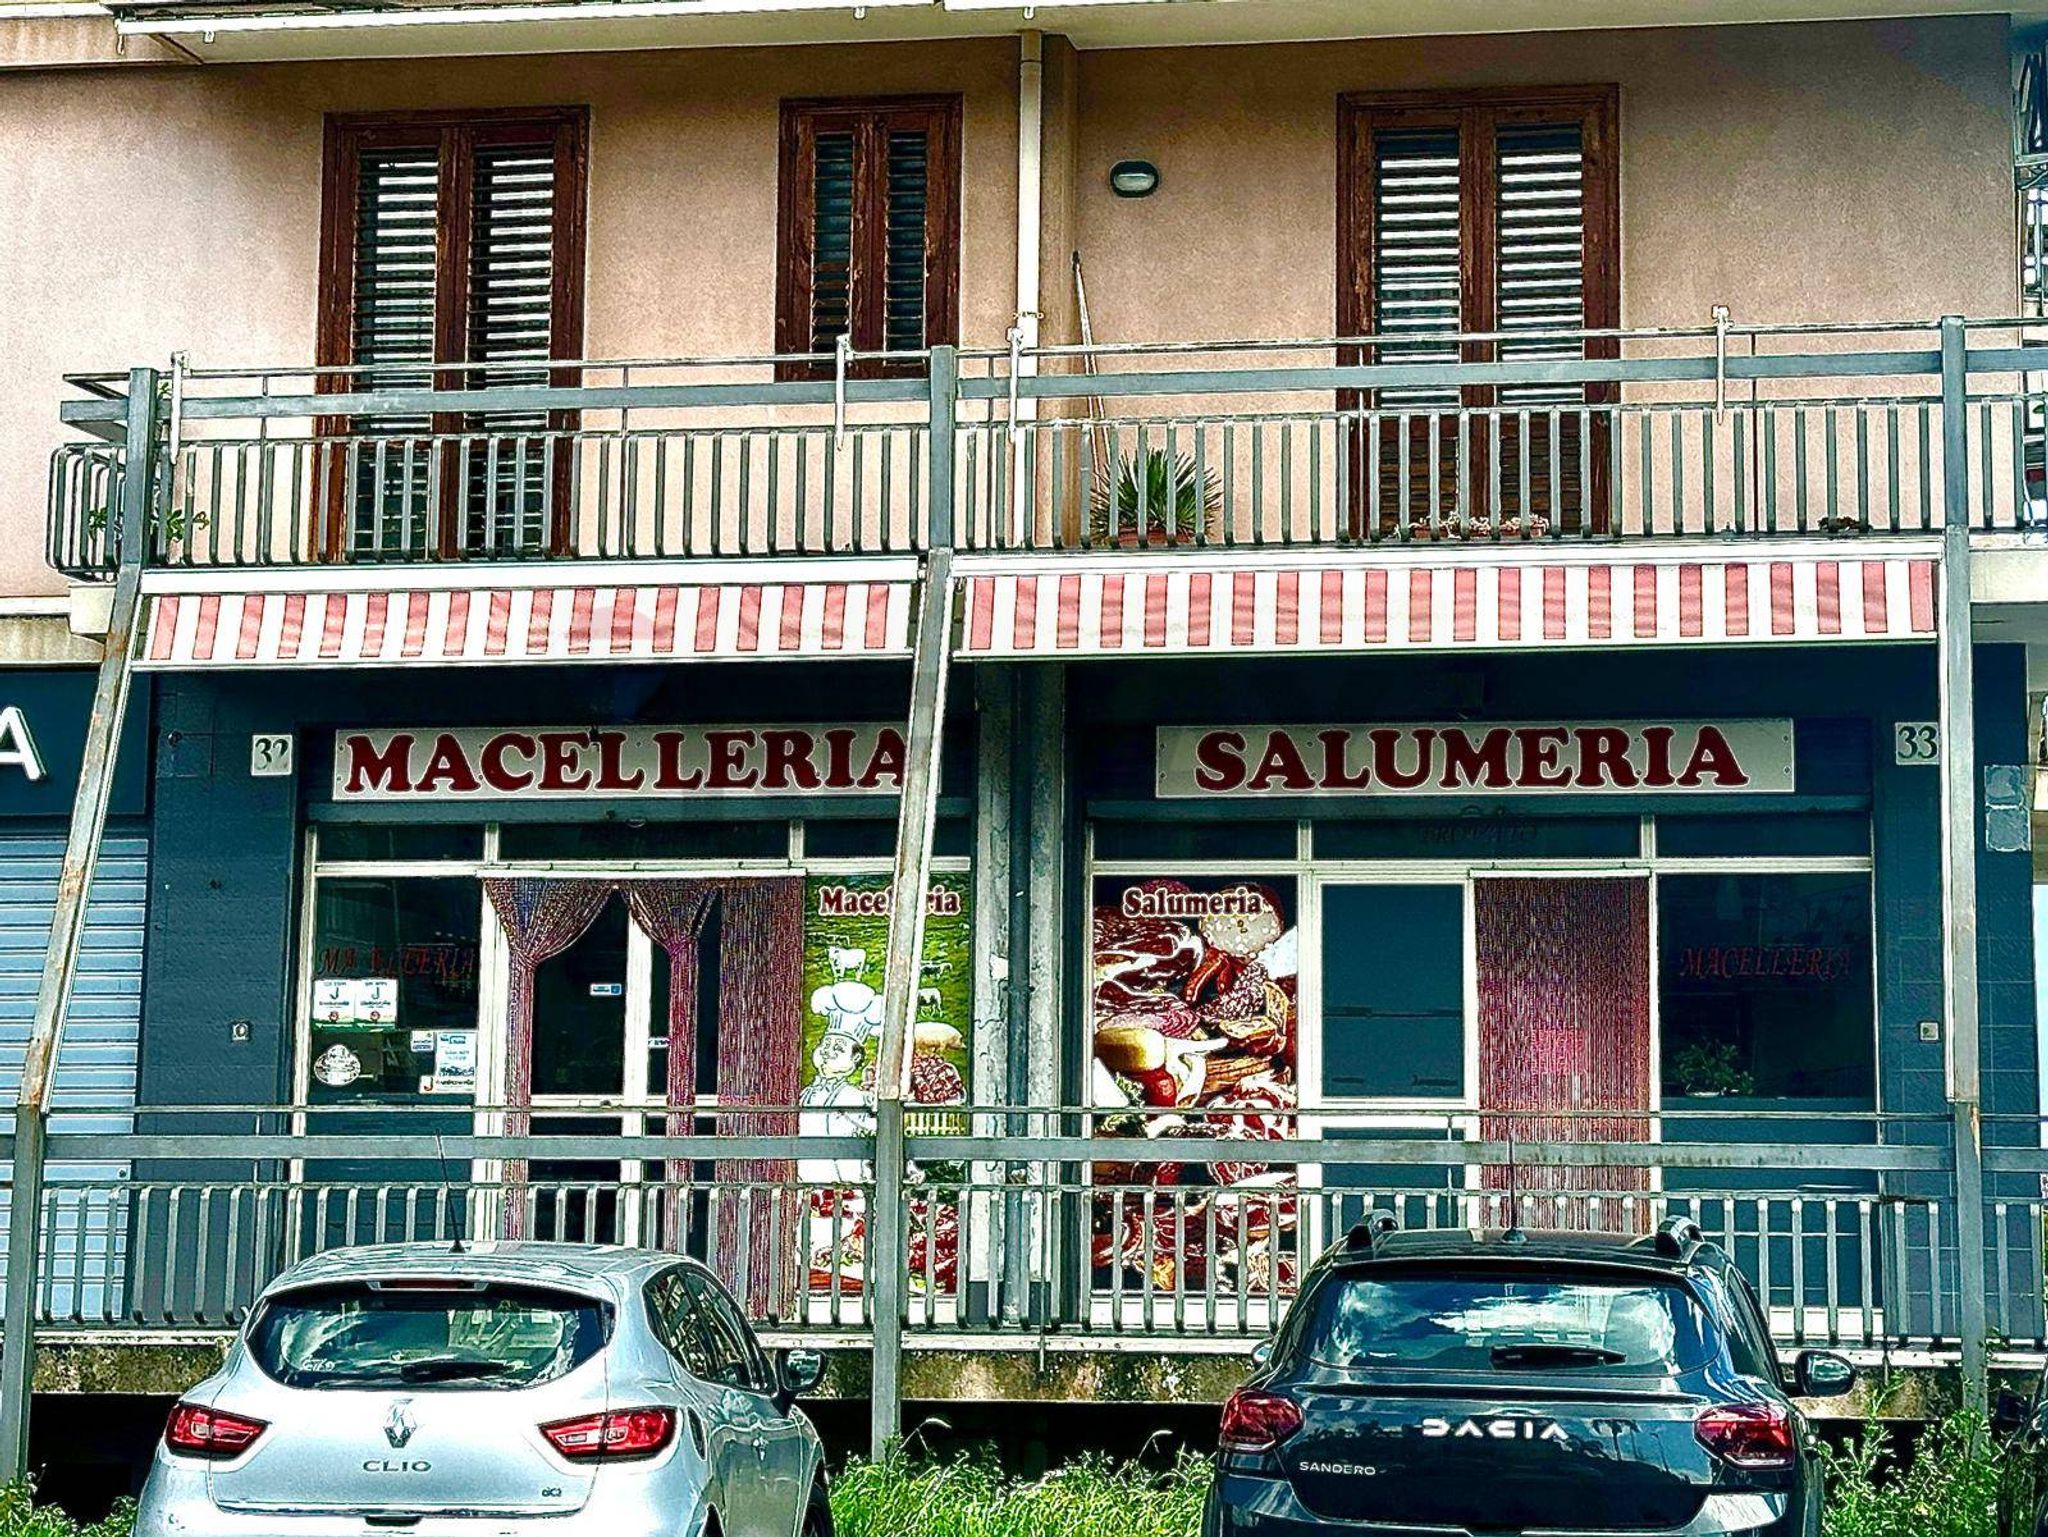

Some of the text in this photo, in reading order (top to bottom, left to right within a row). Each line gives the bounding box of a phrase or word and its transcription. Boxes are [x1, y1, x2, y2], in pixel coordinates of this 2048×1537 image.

[1195, 726, 1749, 789] SALUMERIA
[1898, 725, 1938, 759] 33
[345, 729, 905, 792] MACELLERIA
[1123, 887, 1265, 918] Salumeria
[1421, 1417, 1569, 1439] DACIA
[362, 1460, 432, 1473] CLIO
[1299, 1461, 1376, 1476] SANDERO
